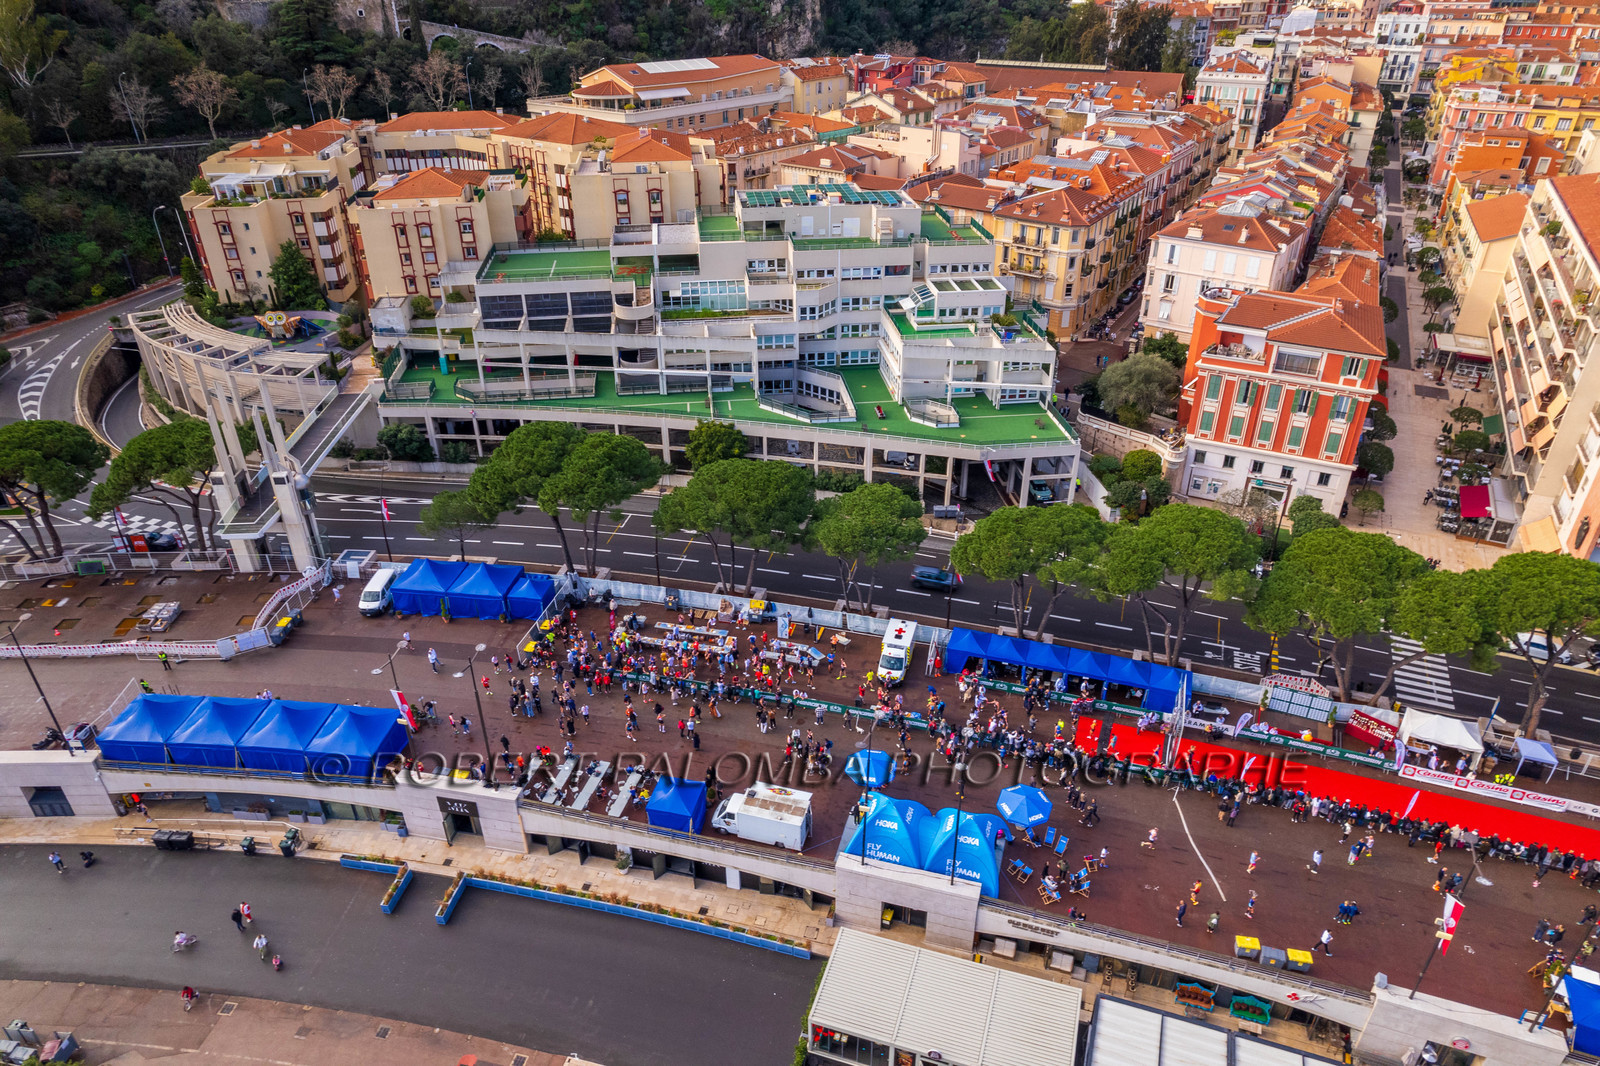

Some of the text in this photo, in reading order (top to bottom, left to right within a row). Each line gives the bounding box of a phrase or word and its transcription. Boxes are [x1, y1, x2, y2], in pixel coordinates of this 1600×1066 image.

[1233, 650, 1262, 674] BUS
[1416, 768, 1456, 782] Casino
[1469, 780, 1510, 794] Casino
[1525, 792, 1567, 806] Casino
[875, 818, 899, 831] HOKA
[1028, 813, 1045, 823] HOKA
[866, 842, 882, 851] FLY
[957, 834, 980, 847] HOKA
[866, 849, 900, 863] HUMAN
[1022, 923, 1040, 931] WILD
[1040, 927, 1060, 936] WEST
